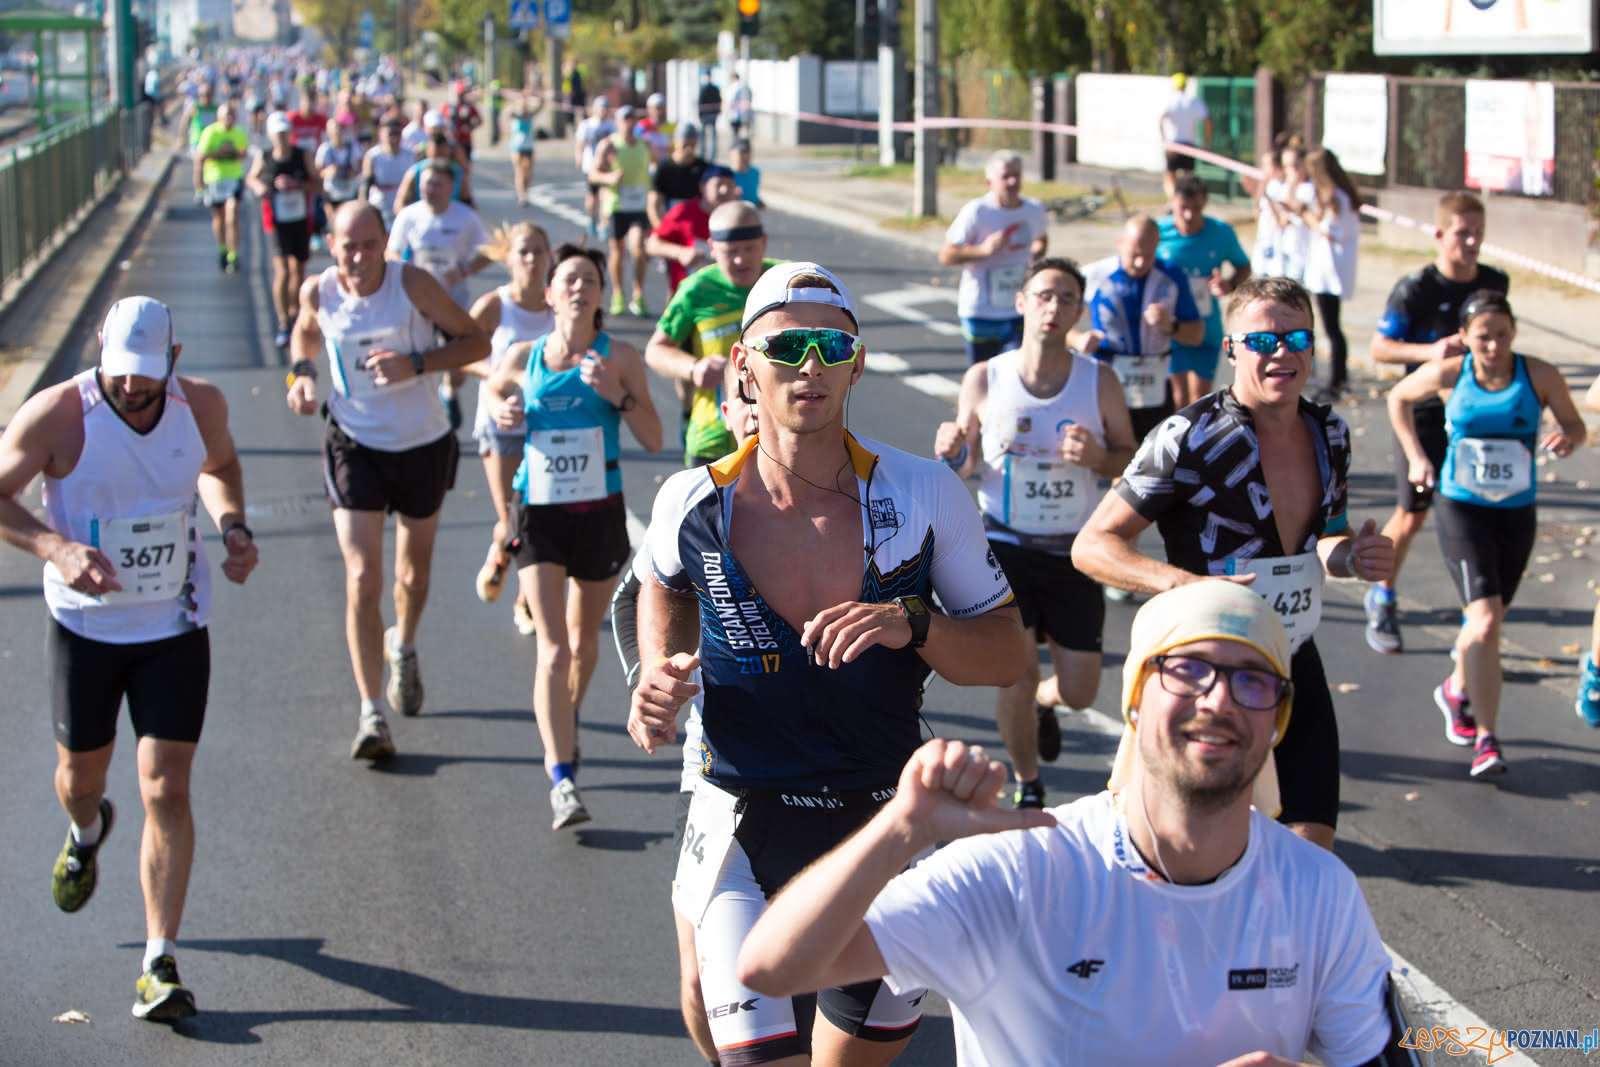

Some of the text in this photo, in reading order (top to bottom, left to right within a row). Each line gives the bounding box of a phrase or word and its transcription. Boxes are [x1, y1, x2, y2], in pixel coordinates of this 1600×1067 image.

[544, 455, 589, 473] 2017
[1025, 480, 1075, 499] 3432
[120, 542, 175, 569] 3677
[701, 552, 754, 650] GRANFONDO
[1261, 587, 1312, 616] 423
[739, 601, 778, 649] STELVIO
[736, 654, 780, 674] 2017
[1066, 959, 1105, 979] 4F
